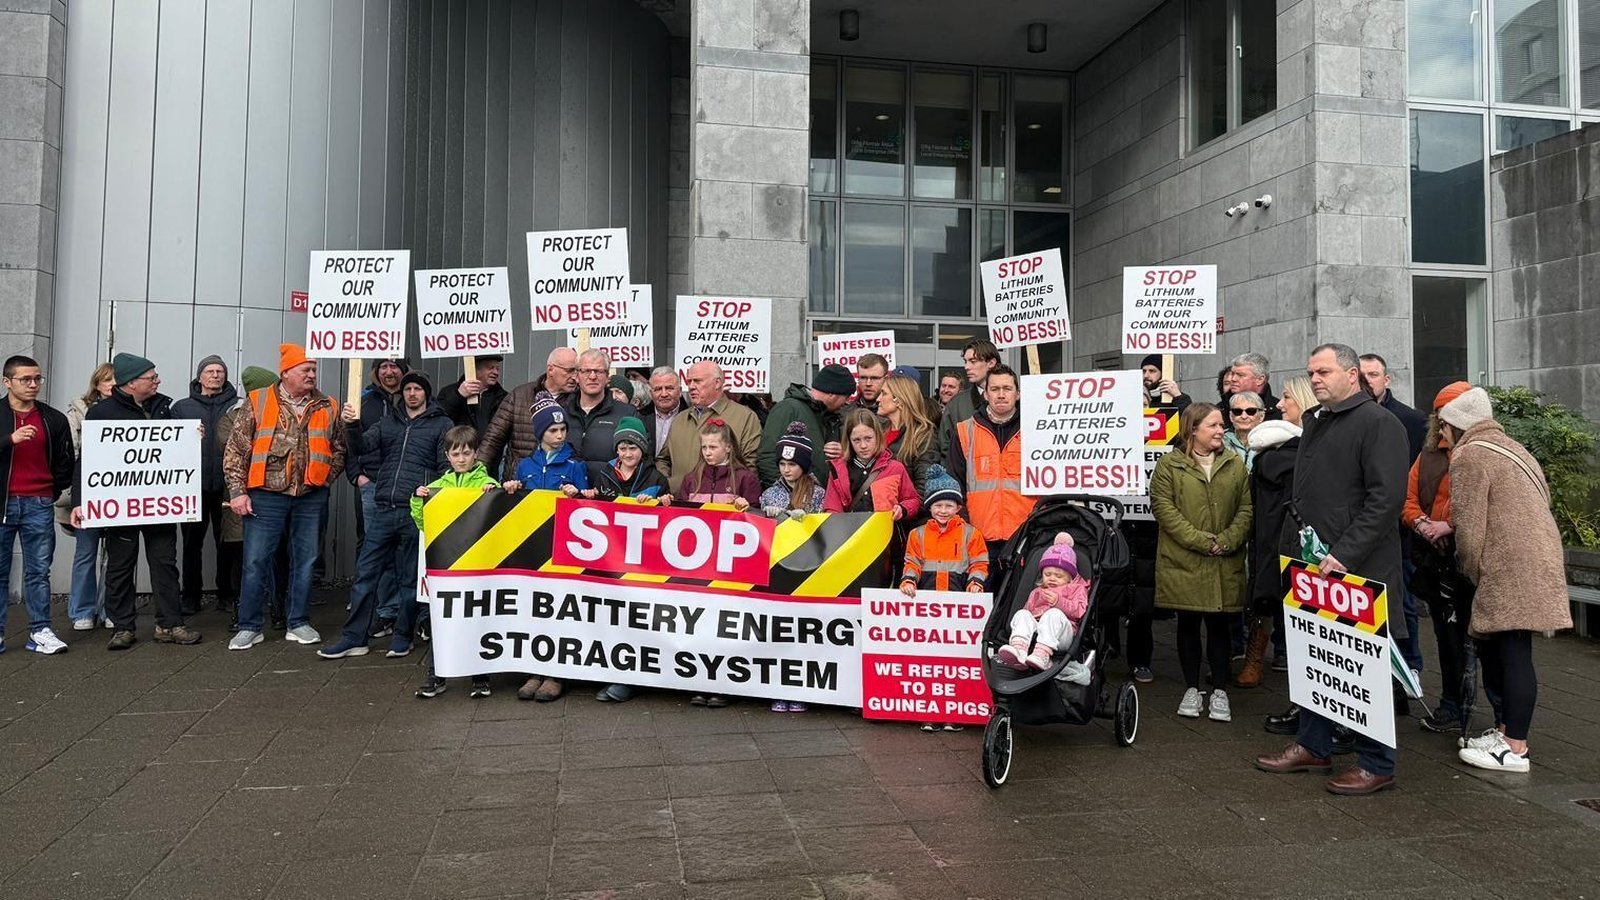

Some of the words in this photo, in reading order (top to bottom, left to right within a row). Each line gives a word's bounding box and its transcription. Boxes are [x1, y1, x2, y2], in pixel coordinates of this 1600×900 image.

[543, 235, 612, 252] PROTECT
[324, 257, 394, 273] PROTECT
[563, 256, 595, 272] OUR
[998, 256, 1043, 278] STOP
[430, 273, 495, 288] PROTECT
[535, 275, 624, 294] COMMUNITY
[1001, 275, 1044, 290] LITHIUM
[1143, 270, 1197, 285] STOP
[342, 280, 374, 295] OUR
[995, 284, 1054, 302] BATTERIES
[1144, 287, 1195, 297] LITHIUM
[449, 292, 479, 306] OUR
[1007, 302, 1018, 311] IN
[1020, 298, 1044, 309] OUR
[1135, 298, 1205, 307] BATTERIES
[312, 303, 401, 318] COMMUNITY
[423, 309, 506, 325] COMMUNITY
[535, 304, 562, 323] NO
[568, 301, 627, 321] BESS!!
[697, 300, 752, 318] STOP
[994, 306, 1060, 324] COMMUNITY
[1147, 310, 1160, 318] IN
[1164, 309, 1191, 318] OUR
[698, 320, 750, 330] LITHIUM
[992, 326, 1014, 344] NO
[1017, 319, 1067, 341] BESS!!
[1130, 320, 1208, 329] COMMUNITY
[310, 331, 336, 350] NO
[342, 331, 401, 350] BESS!!
[424, 335, 449, 352] NO
[454, 331, 510, 350] BESS!!
[688, 332, 759, 343] BATTERIES
[823, 338, 891, 351] UNTESTED
[1126, 332, 1150, 349] NO
[1156, 332, 1212, 349] BESS!!
[701, 344, 714, 353] IN
[717, 345, 746, 354] OUR
[1045, 377, 1116, 400] STOP
[1047, 402, 1114, 415] LITHIUM
[1036, 417, 1127, 430] BATTERIES
[100, 426, 184, 442] PROTECT
[1052, 434, 1068, 445] IN
[1073, 433, 1110, 444] OUR
[124, 448, 161, 464] OUR
[1031, 448, 1132, 460] COMMUNITY
[88, 469, 195, 487] COMMUNITY
[1026, 466, 1056, 488] NO
[1064, 465, 1139, 488] BESS!!
[87, 499, 119, 519] NO
[127, 496, 197, 517] BESS!!
[566, 507, 760, 573] STOP
[1296, 572, 1369, 617] STOP
[436, 589, 519, 618] THE
[532, 591, 705, 635] BATTERY
[717, 609, 862, 646] ENERG
[870, 601, 986, 619] UNTESTED
[1289, 614, 1315, 636] THE
[1319, 625, 1382, 659] BATTERY
[479, 631, 661, 674] STORAGE
[674, 651, 838, 691] SYSTEM
[1308, 644, 1364, 677] ENERGY
[874, 662, 902, 676] WE
[908, 664, 982, 680] REFUSE
[900, 681, 925, 695] TO
[932, 682, 956, 697] BE
[1306, 666, 1371, 704] STORAGE
[868, 697, 940, 714] GUINEA
[1312, 691, 1367, 727] SYSTEM
